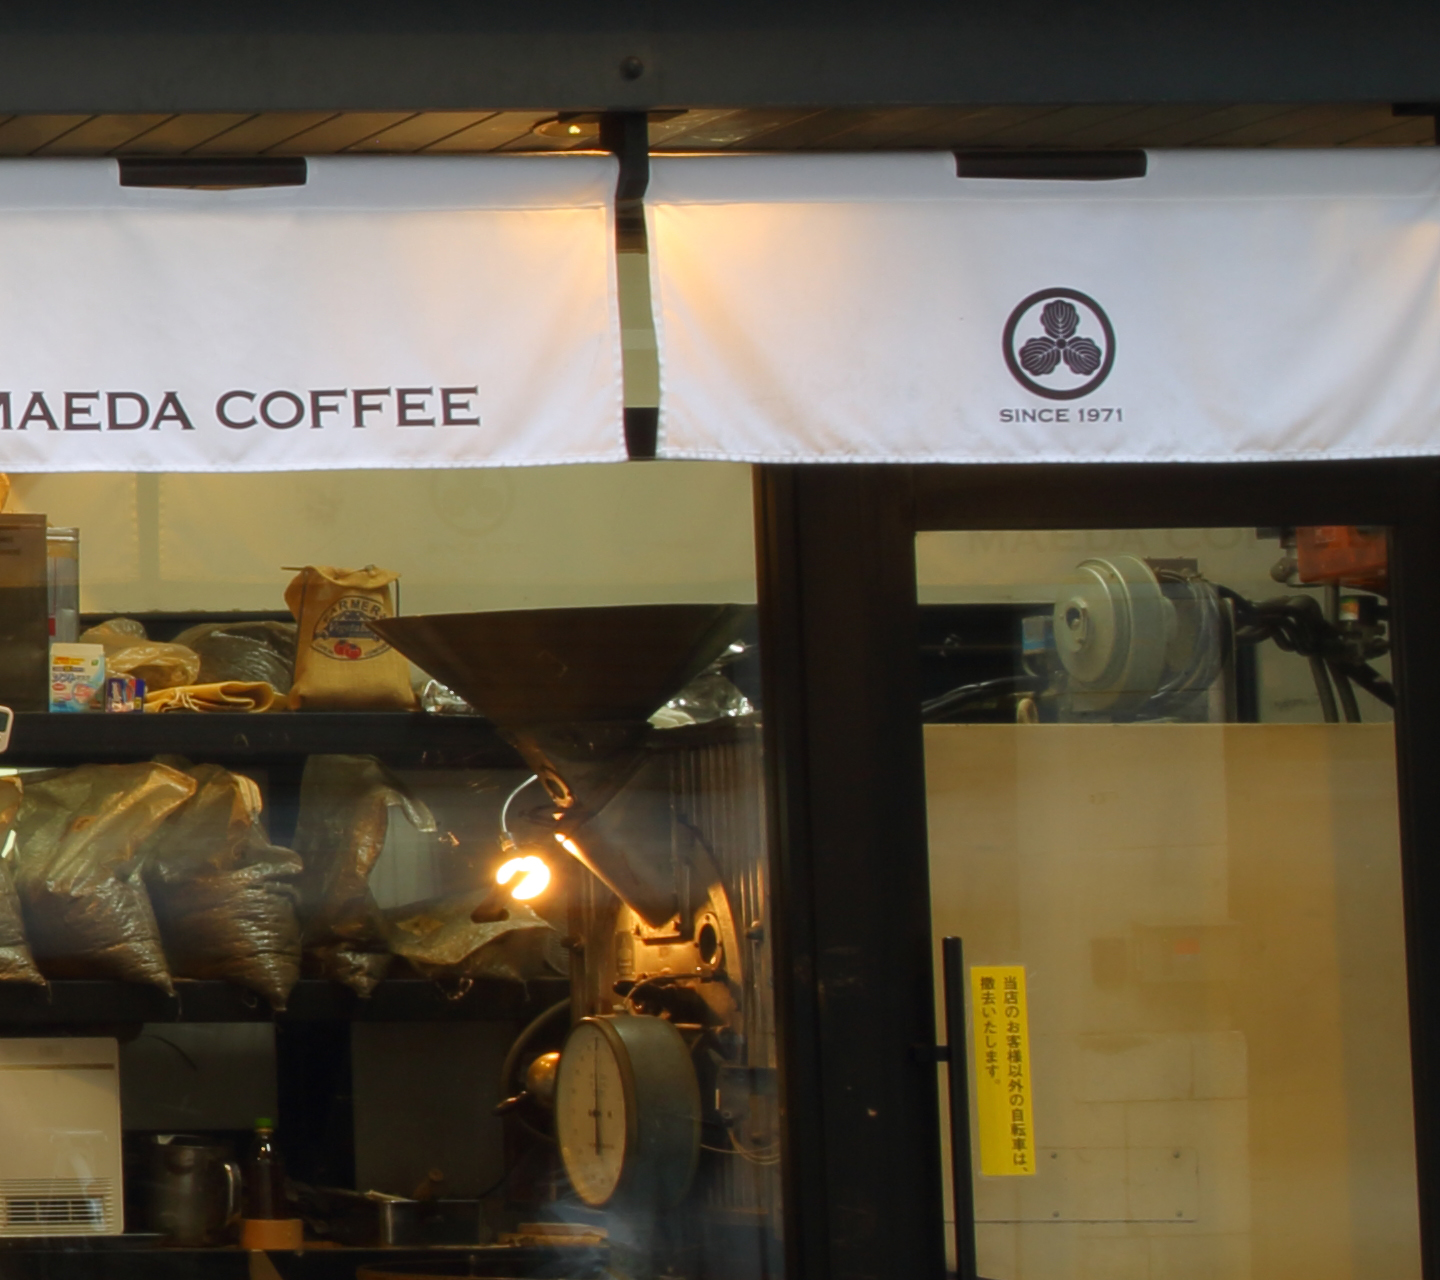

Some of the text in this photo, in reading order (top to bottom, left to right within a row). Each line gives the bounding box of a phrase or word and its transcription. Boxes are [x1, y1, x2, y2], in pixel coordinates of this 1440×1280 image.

[215, 385, 481, 430] COFFEE
[999, 408, 1123, 422] SINCE 1971
[979, 976, 1001, 1086] 撤去いたします。
[1003, 975, 1028, 1173] 当店のお客様以外の自転車は、
